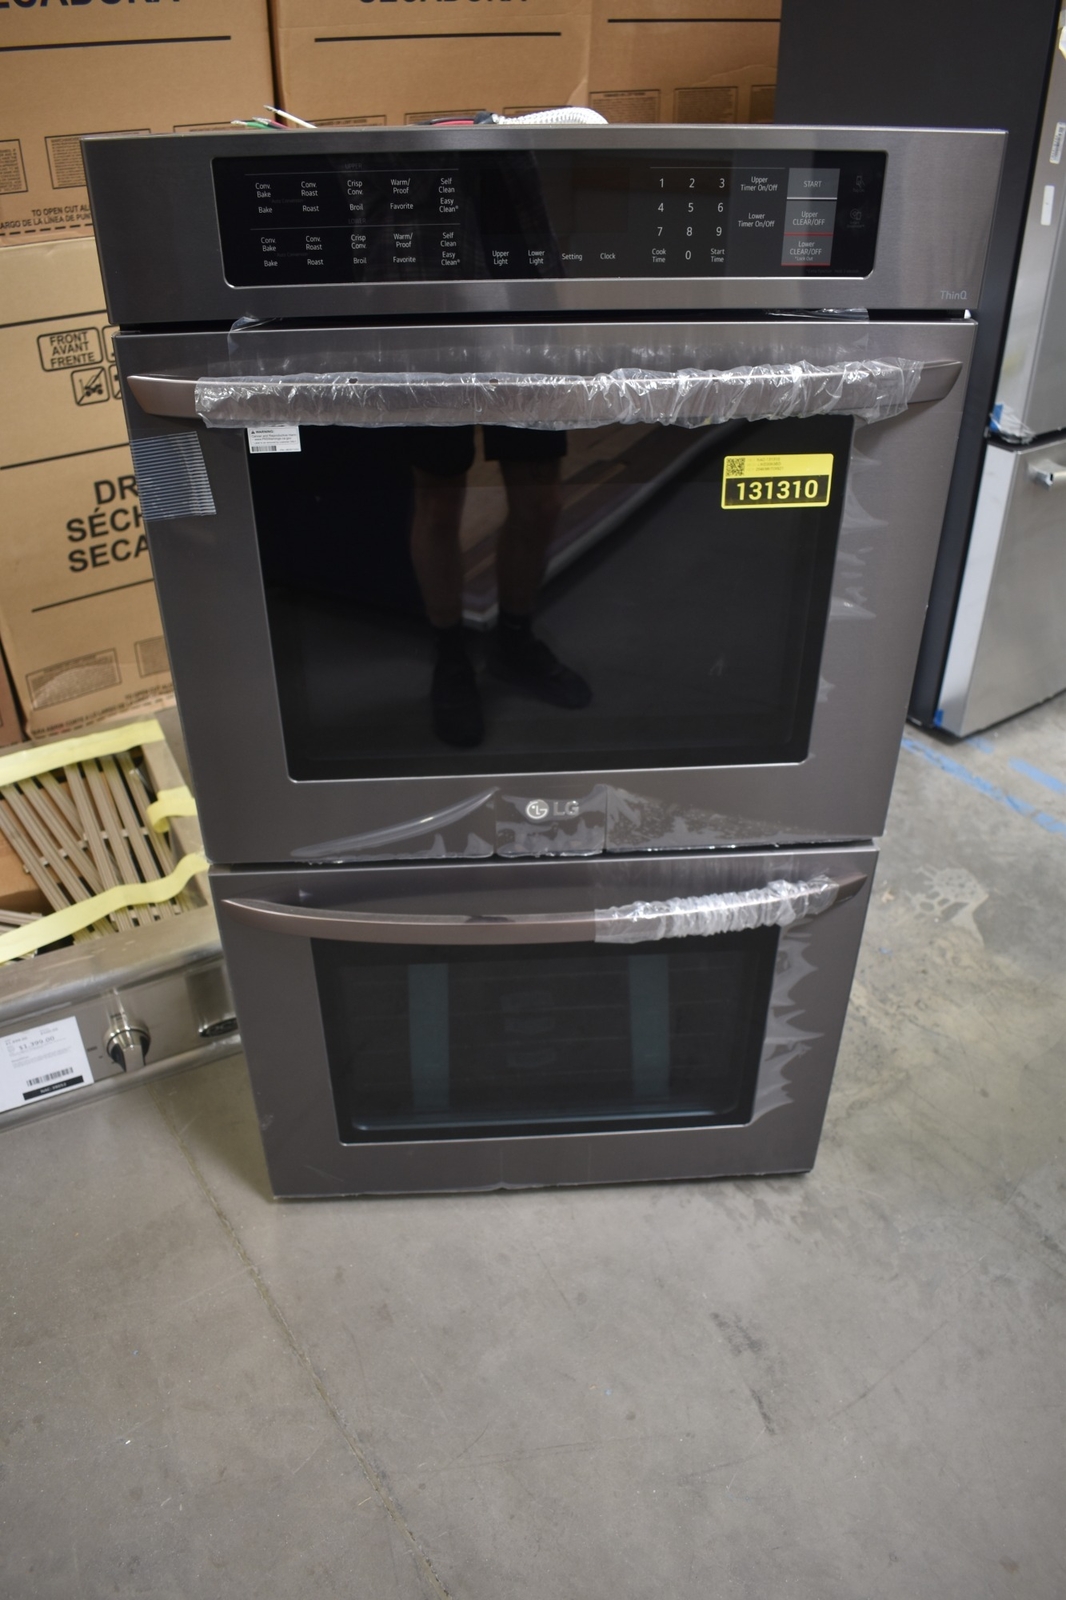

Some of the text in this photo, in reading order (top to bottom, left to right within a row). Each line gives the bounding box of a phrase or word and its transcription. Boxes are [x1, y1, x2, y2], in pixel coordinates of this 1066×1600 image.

[347, 179, 363, 188] Crisp
[390, 177, 411, 186] Warm/
[440, 177, 453, 185] Self
[659, 178, 665, 188] 1
[689, 177, 696, 188] 2
[719, 177, 725, 189] 3
[751, 176, 768, 184] Upper
[392, 187, 409, 195] Proof
[438, 186, 455, 194] Clean
[757, 184, 778, 192] On/Off
[256, 191, 272, 199] Bake
[440, 197, 454, 205] Easy
[31, 209, 42, 217] TO
[43, 207, 63, 216] OPEN
[64, 205, 78, 214] CUT
[258, 206, 273, 214] Bake
[349, 203, 364, 211] Broil
[657, 202, 664, 213] 4
[688, 202, 694, 213] 5
[717, 202, 724, 213] 6
[22, 219, 32, 227] DE
[33, 218, 43, 226] LA
[65, 214, 75, 222] DE
[755, 220, 775, 228] On/Off
[442, 231, 454, 239] Self
[657, 226, 663, 236] 7
[686, 226, 693, 237] 8
[716, 226, 722, 237] 9
[350, 234, 367, 242] Crisp
[393, 232, 413, 240] Warm/
[305, 243, 323, 251] Roast
[441, 251, 456, 259] Easy
[561, 253, 583, 261] Setting
[685, 250, 692, 260] 0
[493, 258, 508, 266] Light
[529, 257, 544, 266] Light
[940, 290, 967, 300] ThinQ
[49, 331, 88, 346] FRONT
[52, 341, 89, 356] AVANT
[50, 351, 95, 368] FRENTE
[94, 475, 139, 505] DR
[737, 480, 818, 500] 131310
[68, 534, 149, 573] SECA
[553, 800, 579, 816] LG
